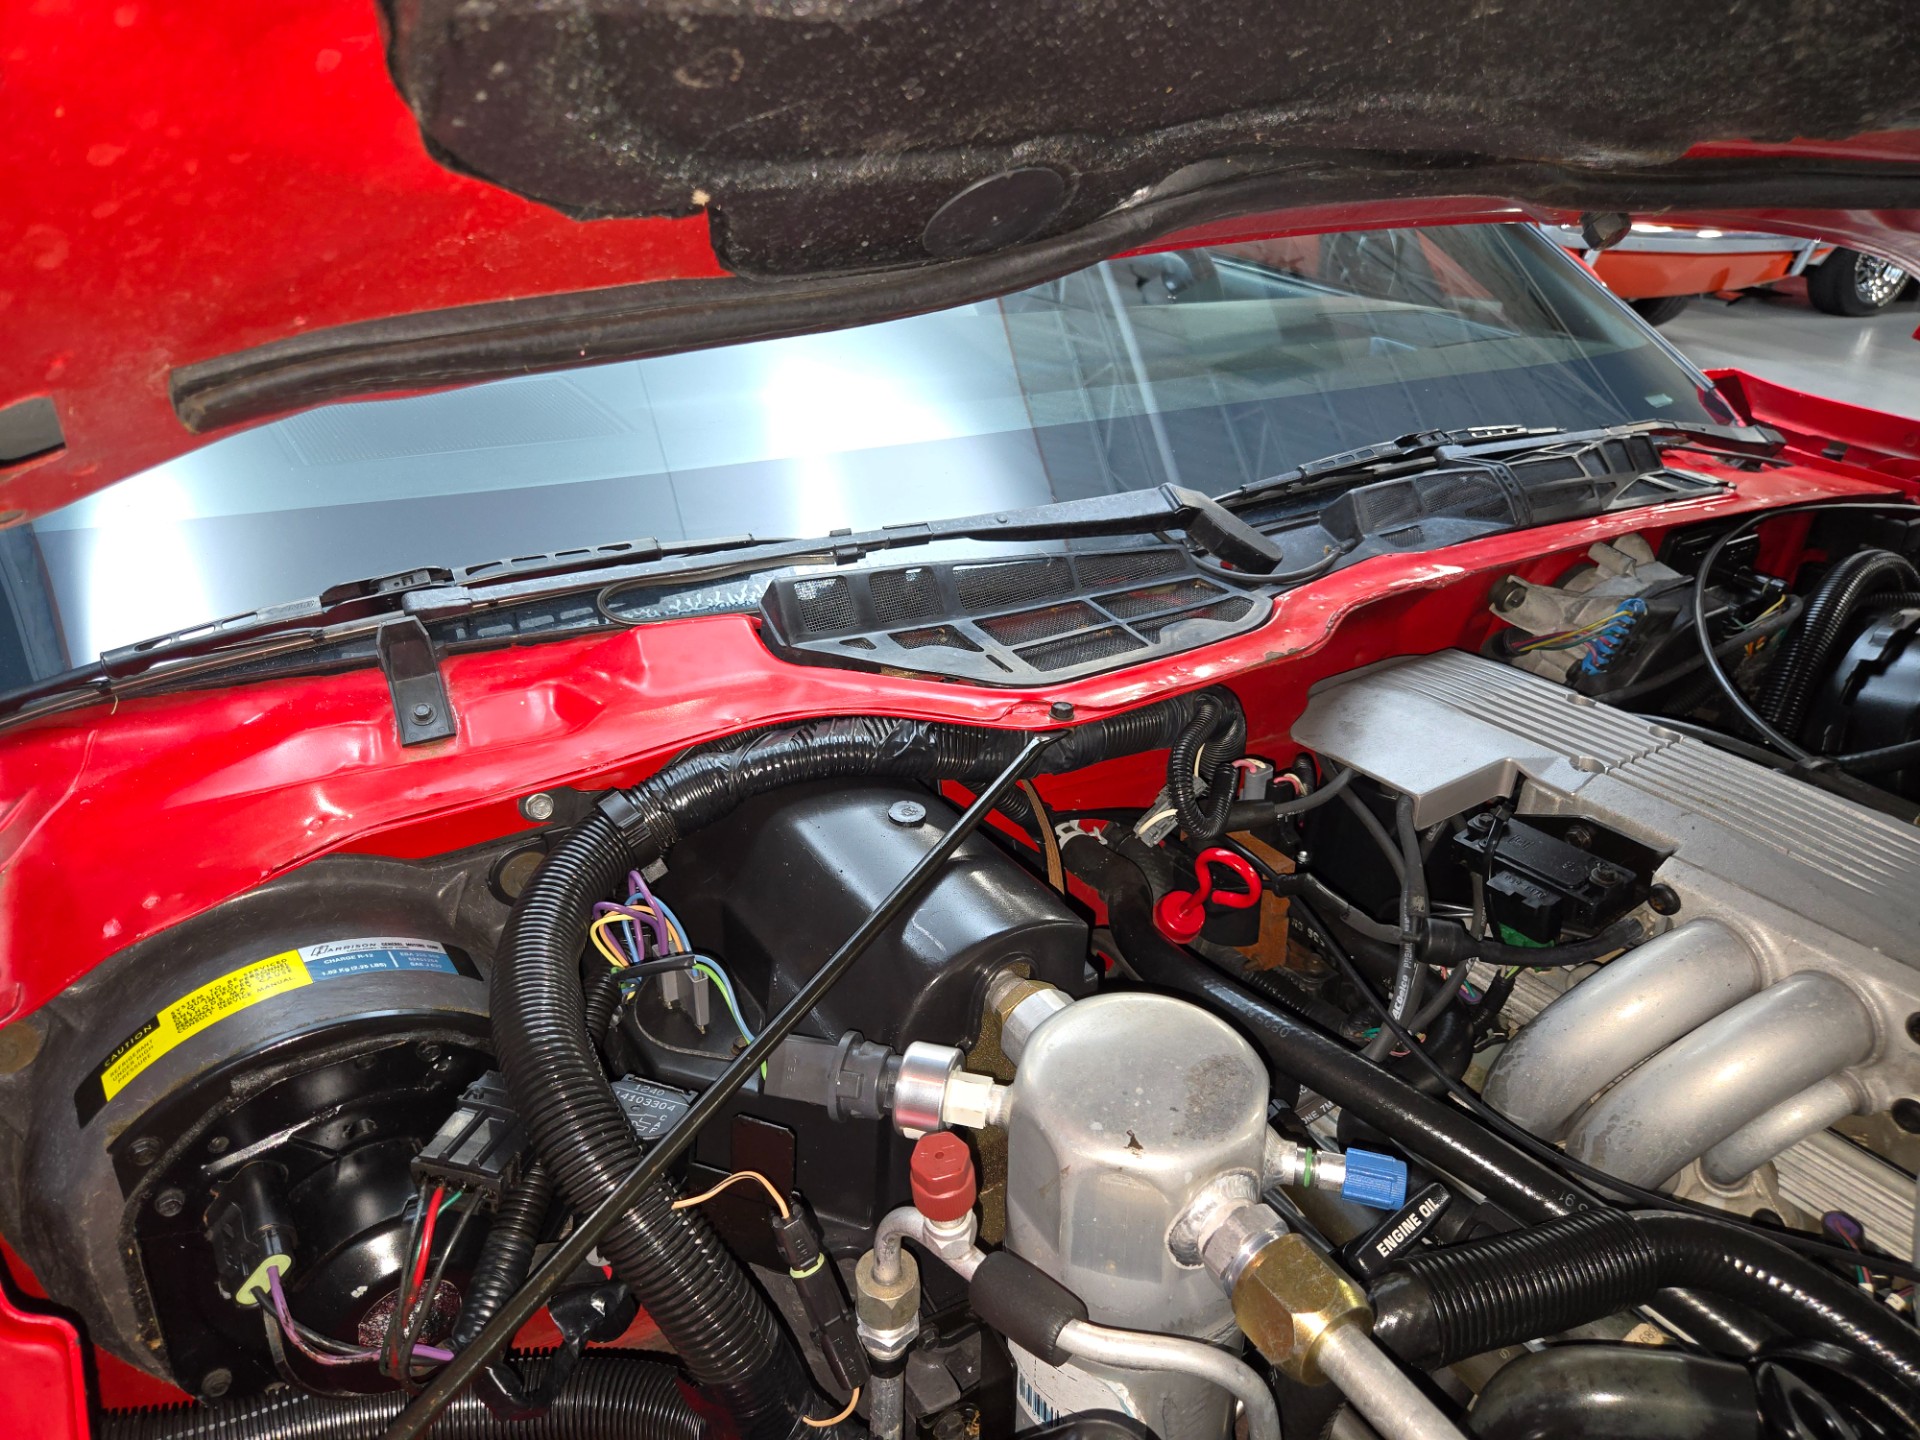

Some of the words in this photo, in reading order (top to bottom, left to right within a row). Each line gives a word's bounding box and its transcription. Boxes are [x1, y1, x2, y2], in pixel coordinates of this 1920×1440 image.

[323, 954, 357, 965] CHARGE
[104, 1024, 153, 1067] CAUTION
[634, 1084, 666, 1096] 1240
[1375, 1212, 1423, 1258] ENGINE
[1418, 1197, 1440, 1218] OIL
